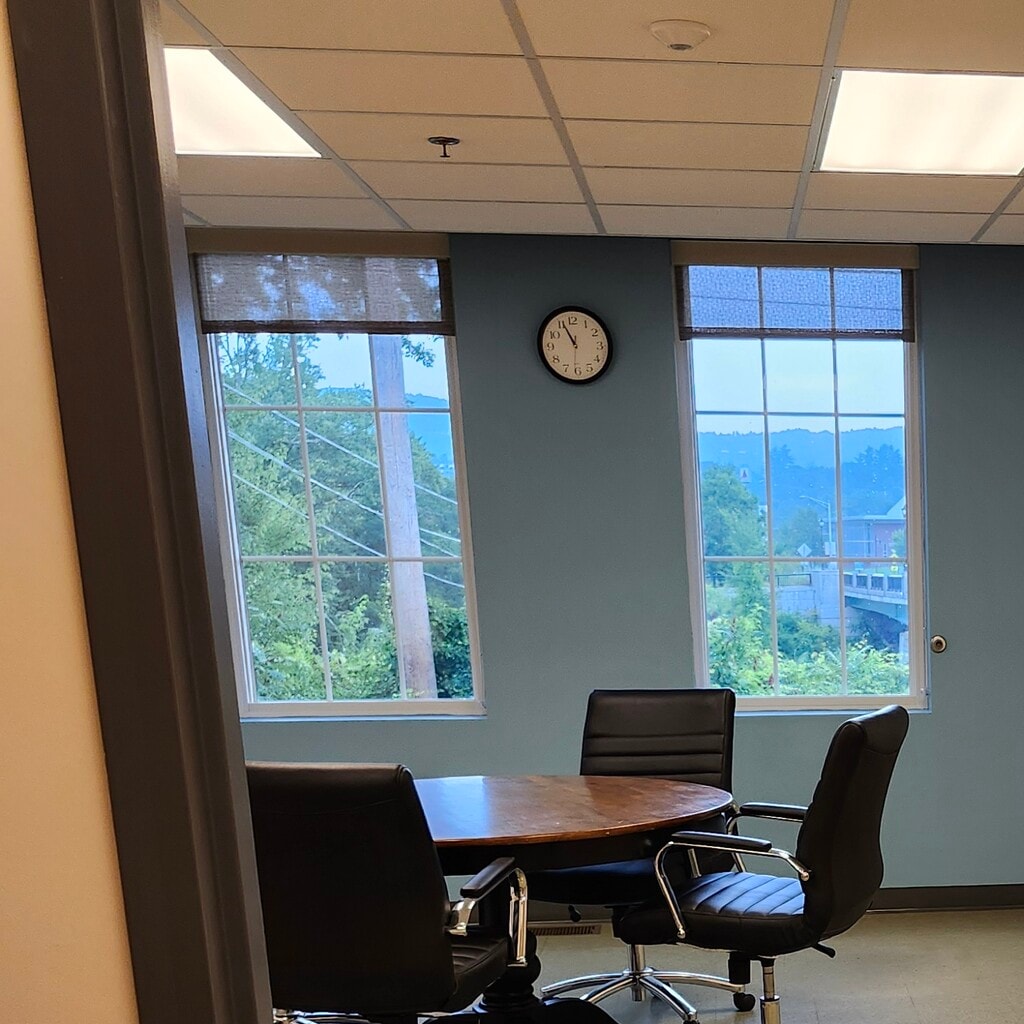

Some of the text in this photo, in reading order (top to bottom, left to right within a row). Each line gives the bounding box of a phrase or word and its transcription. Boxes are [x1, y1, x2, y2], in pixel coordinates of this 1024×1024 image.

[568, 316, 578, 326] 12
[584, 320, 588, 329] 1
[550, 330, 561, 340] 10
[591, 328, 599, 337] 2
[546, 342, 555, 351] 9
[596, 341, 604, 350] 3
[552, 355, 560, 363] 8
[593, 354, 601, 363] 4
[562, 363, 570, 373] 7
[574, 366, 582, 376] 6
[585, 363, 594, 373] 5
